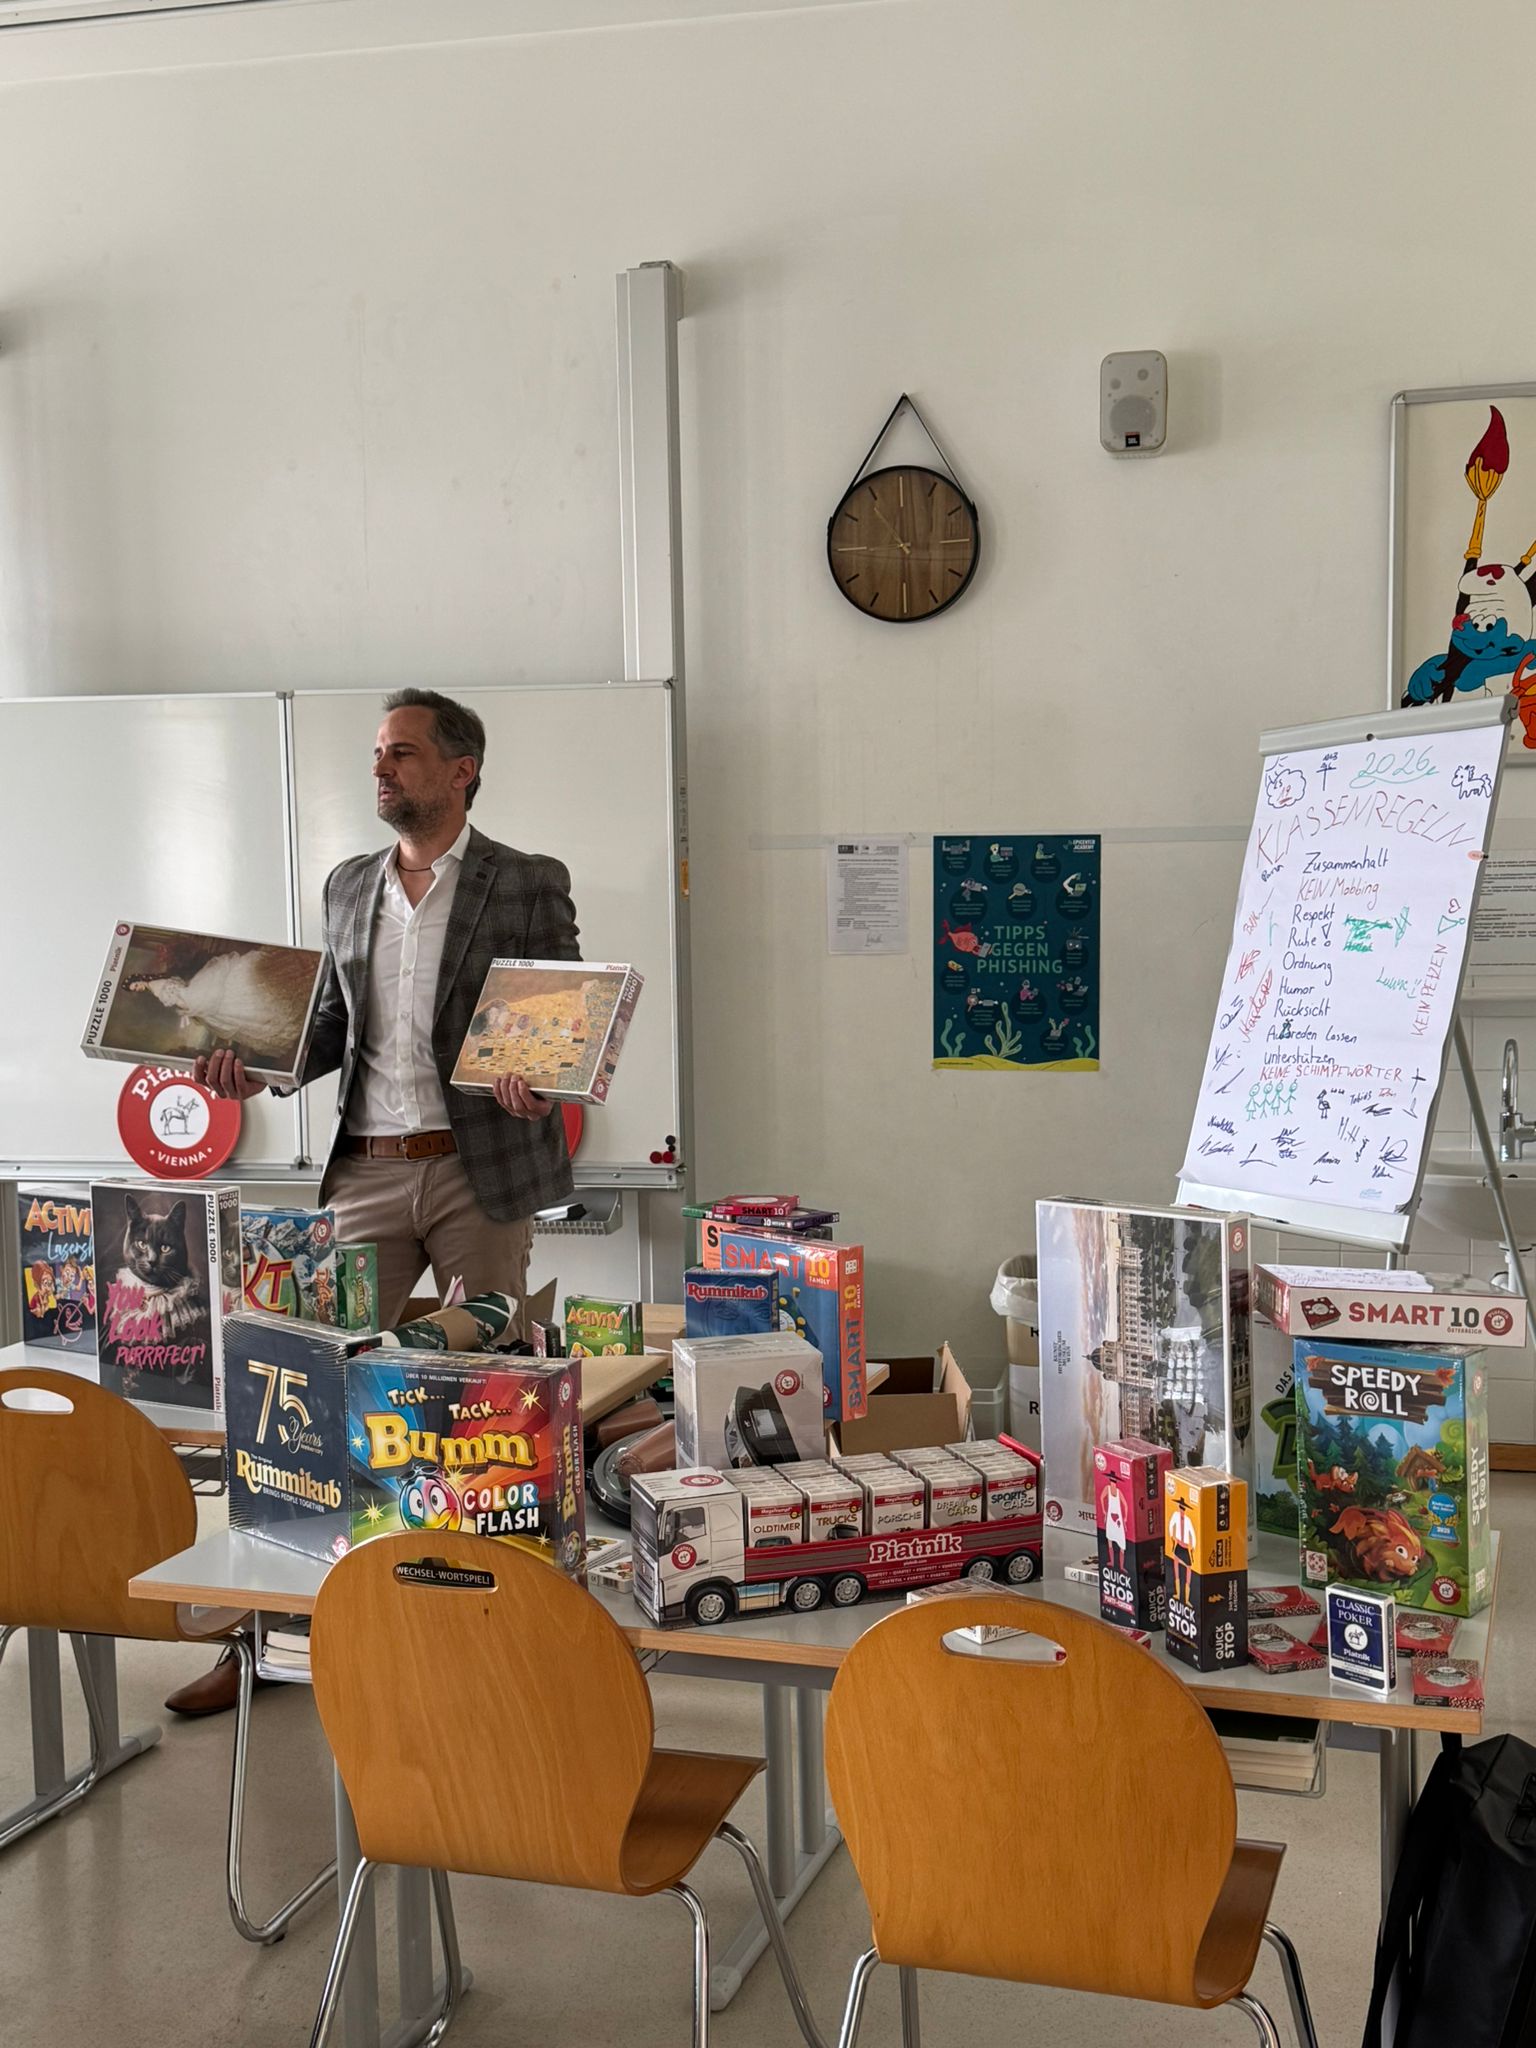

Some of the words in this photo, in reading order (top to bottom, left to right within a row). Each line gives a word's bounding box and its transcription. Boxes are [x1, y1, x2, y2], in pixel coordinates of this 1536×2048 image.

[1361, 747, 1431, 779] 2026
[1257, 791, 1475, 870] KLASSENREGELN
[1303, 845, 1389, 874] Zusammenhalt
[1297, 877, 1331, 902] KEIN
[1329, 877, 1380, 911] Mobbing
[1292, 903, 1336, 928] Respekt
[993, 925, 1046, 940] TIPPS
[991, 942, 1049, 957] GEGEN
[492, 958, 517, 967] PUZZLE
[517, 959, 535, 968] 1000
[976, 959, 1064, 974] PHISHING
[1283, 951, 1333, 987] Ordnung
[1420, 944, 1448, 997] PETZEN
[626, 979, 638, 1003] 1000
[1279, 975, 1315, 996] Humor
[86, 1007, 105, 1045] PUZZLE
[99, 980, 113, 1003] 1000
[1274, 998, 1331, 1018] Rücksicht
[1411, 1000, 1431, 1036] KEIN
[1264, 1045, 1336, 1065] unterstützen
[1259, 1065, 1291, 1081] KEINE
[1296, 1064, 1403, 1082] SCHIMPFWÖRTER
[157, 1150, 208, 1167] VIENNA
[218, 1191, 239, 1201] PUZZLE
[219, 1199, 238, 1210] 1000
[208, 1194, 217, 1234] PUZZLE
[742, 1206, 773, 1215] SMART
[774, 1207, 784, 1216] 10
[208, 1237, 217, 1263] 1000
[724, 1243, 802, 1280] SMART
[808, 1258, 831, 1279] 10
[808, 1276, 831, 1286] FAMILY
[687, 1282, 769, 1300] Rummikub
[844, 1284, 857, 1311] 10
[566, 1305, 624, 1329] ACTIVITY
[1348, 1302, 1446, 1326] SMART
[1450, 1307, 1480, 1327] 10
[116, 1344, 206, 1371] PURRRFECT!
[848, 1318, 862, 1410] SMART
[405, 1372, 420, 1380] ÜBER
[428, 1374, 458, 1382] MILLIONEN
[1275, 1370, 1292, 1394] DAS
[1331, 1364, 1422, 1397] SPEEDY
[214, 1376, 222, 1411] Piatnik
[248, 1359, 313, 1445] 75
[1344, 1387, 1409, 1417] ROLL
[288, 1415, 324, 1455] Years
[364, 1412, 538, 1471] Bumm
[236, 1449, 342, 1510] Rummikub
[562, 1422, 577, 1522] Bumm
[1478, 1451, 1487, 1510] ROLL
[463, 1483, 535, 1511] COLOR
[991, 1490, 1028, 1505] SPORTS
[1470, 1447, 1481, 1526] SPEEDY
[281, 1492, 299, 1505] PEOPLE
[299, 1498, 326, 1514] TOGETHER
[947, 1504, 978, 1517] CARS
[1001, 1498, 1036, 1511] CARS
[476, 1507, 540, 1535] FLASH
[753, 1522, 801, 1534] OLDTIMER
[816, 1513, 858, 1527] TRUCKS
[877, 1511, 922, 1525] PORSCHE
[869, 1532, 963, 1564] Piatnik
[1102, 1566, 1132, 1589] QUICK
[1102, 1582, 1134, 1604] STOP
[1157, 1585, 1167, 1622] STOP
[1149, 1590, 1158, 1622] QUICK
[1168, 1598, 1197, 1624] QUICK
[1336, 1598, 1376, 1616] CLASSIC
[1338, 1609, 1373, 1628] POKER
[1168, 1613, 1198, 1639] STOP
[1215, 1625, 1225, 1660] QUICK
[1224, 1621, 1236, 1659] STOP
[1343, 1648, 1371, 1662] Piatnik
